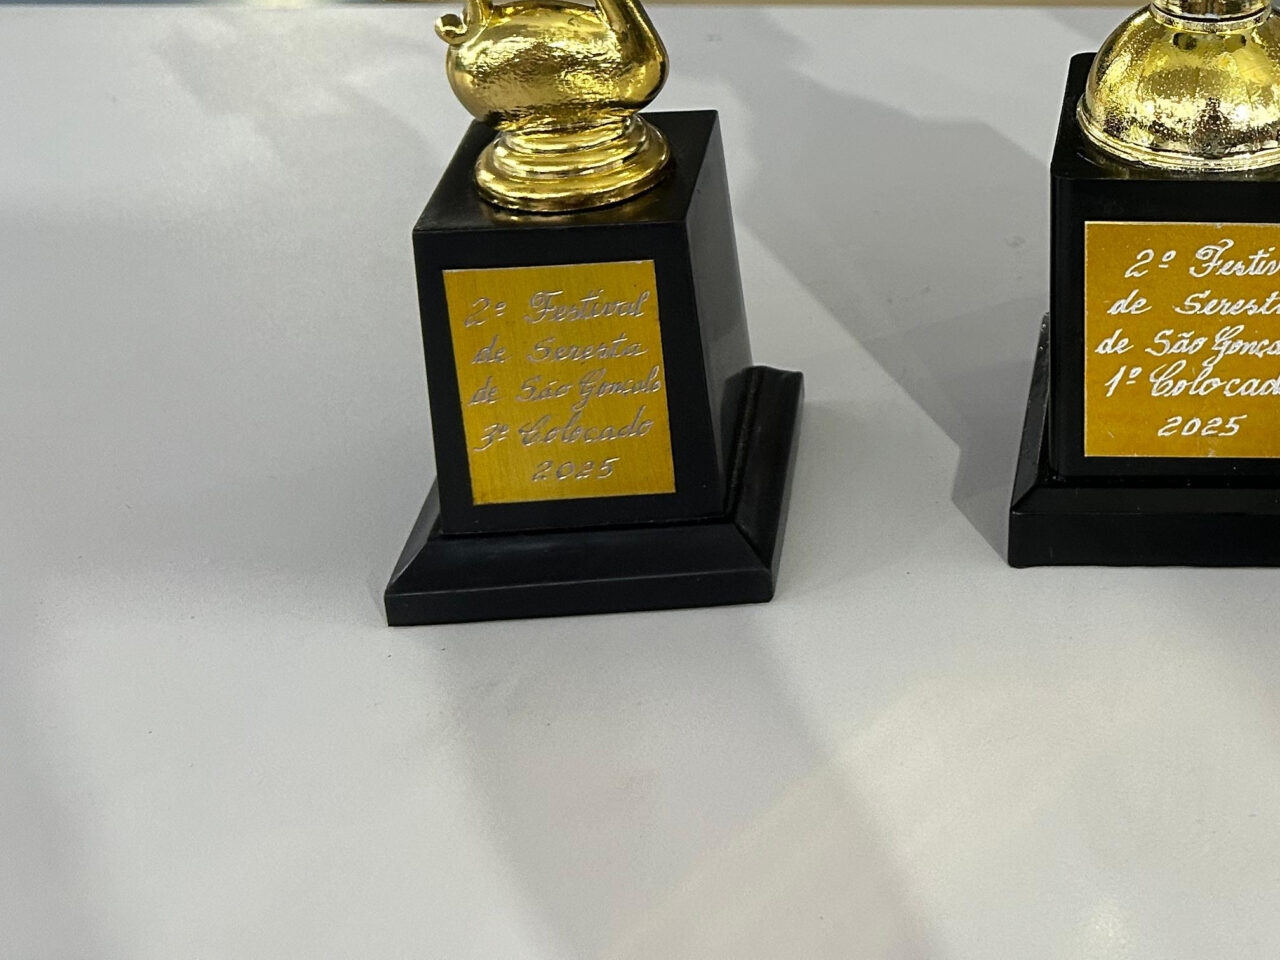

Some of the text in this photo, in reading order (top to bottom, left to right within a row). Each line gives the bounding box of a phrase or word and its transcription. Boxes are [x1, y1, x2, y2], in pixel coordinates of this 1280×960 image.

[1124, 249, 1177, 278] 2º
[523, 289, 651, 324] Festival
[1107, 289, 1153, 315] de
[471, 332, 649, 365] de Seresta
[1095, 329, 1135, 355] de
[1145, 328, 1209, 357] São
[467, 375, 500, 407] de
[517, 403, 655, 448] Colocado
[1157, 414, 1248, 438] 2025
[531, 456, 621, 482] 2025
